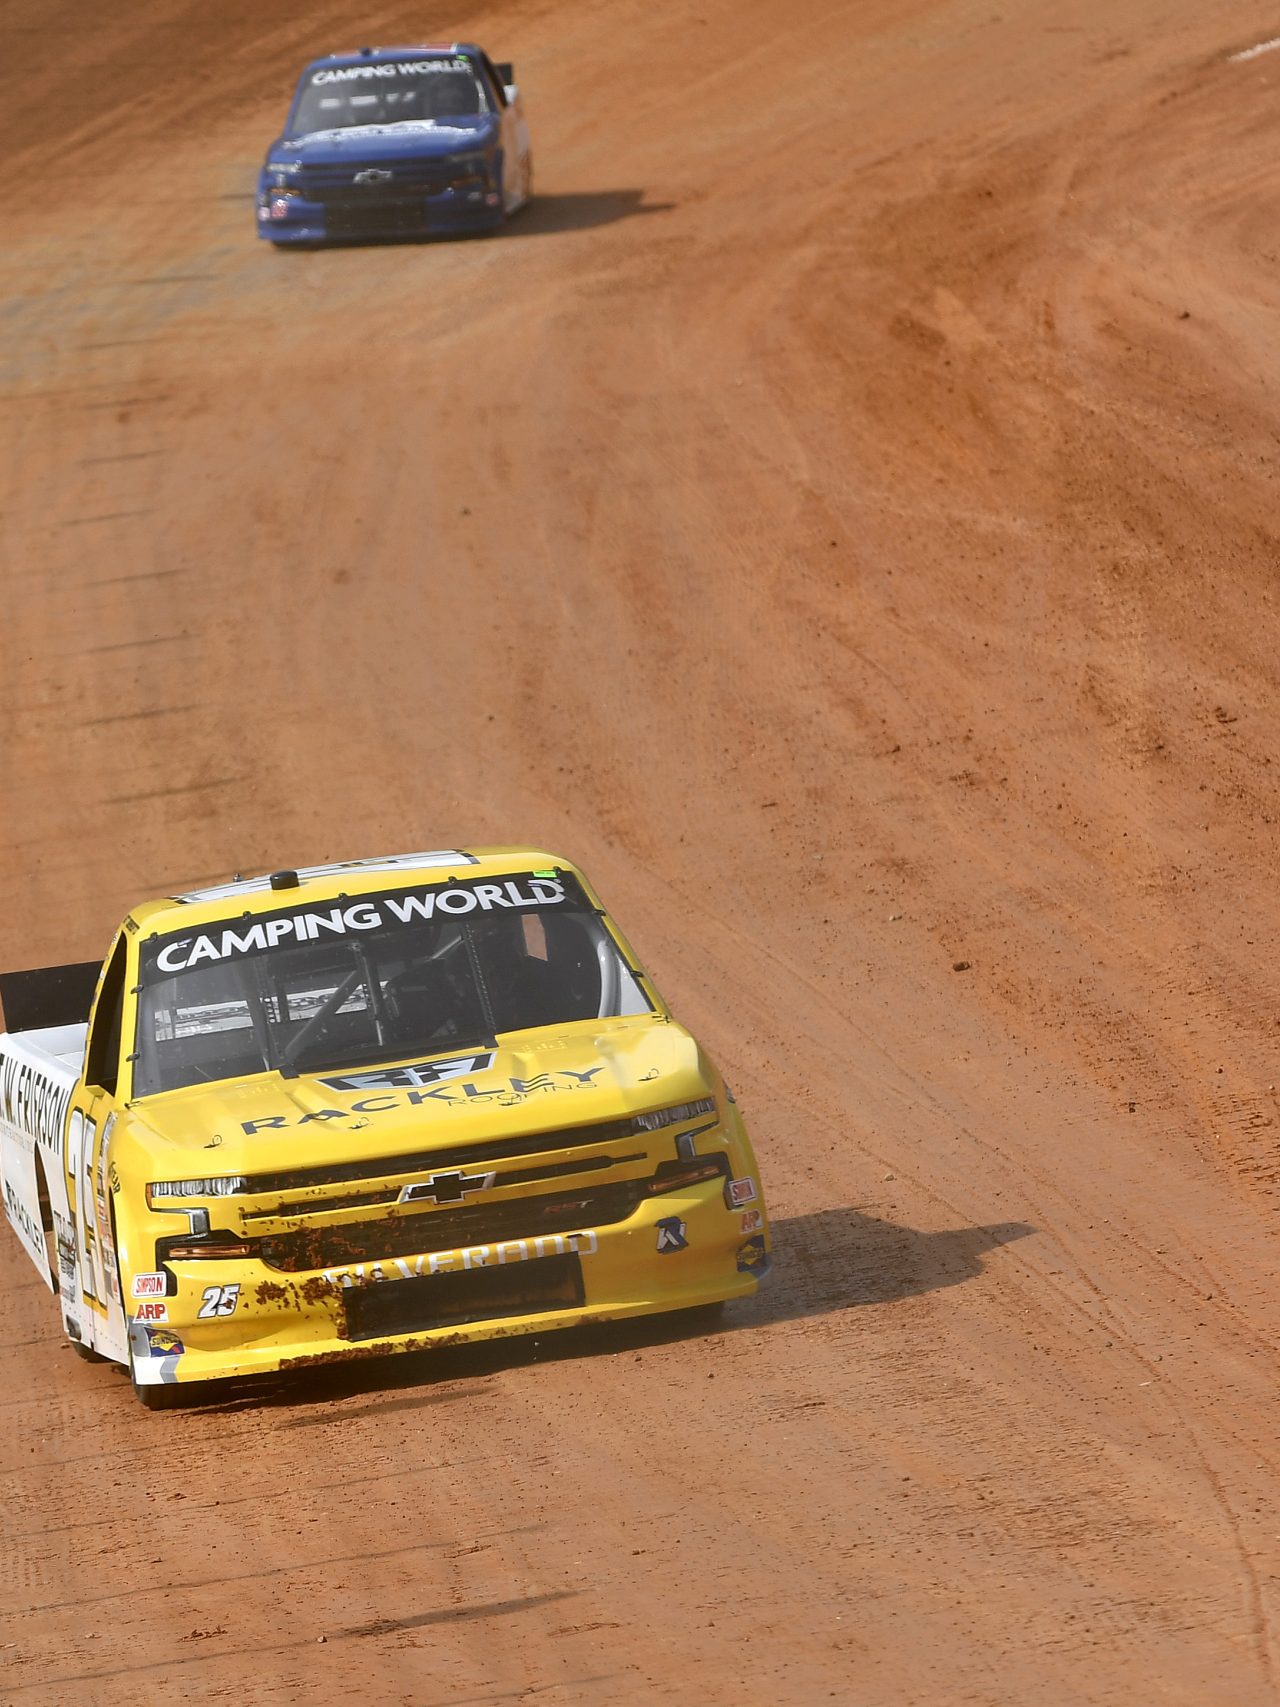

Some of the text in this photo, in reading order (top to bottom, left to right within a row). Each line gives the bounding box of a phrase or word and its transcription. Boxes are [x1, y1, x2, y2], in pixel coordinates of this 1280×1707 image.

[312, 60, 468, 86] CAMPING WORLD
[156, 879, 566, 973] CAMPING WORLD
[239, 1067, 606, 1136] RACKLEY
[136, 1303, 165, 1319] ARP
[196, 1283, 241, 1319] 25
